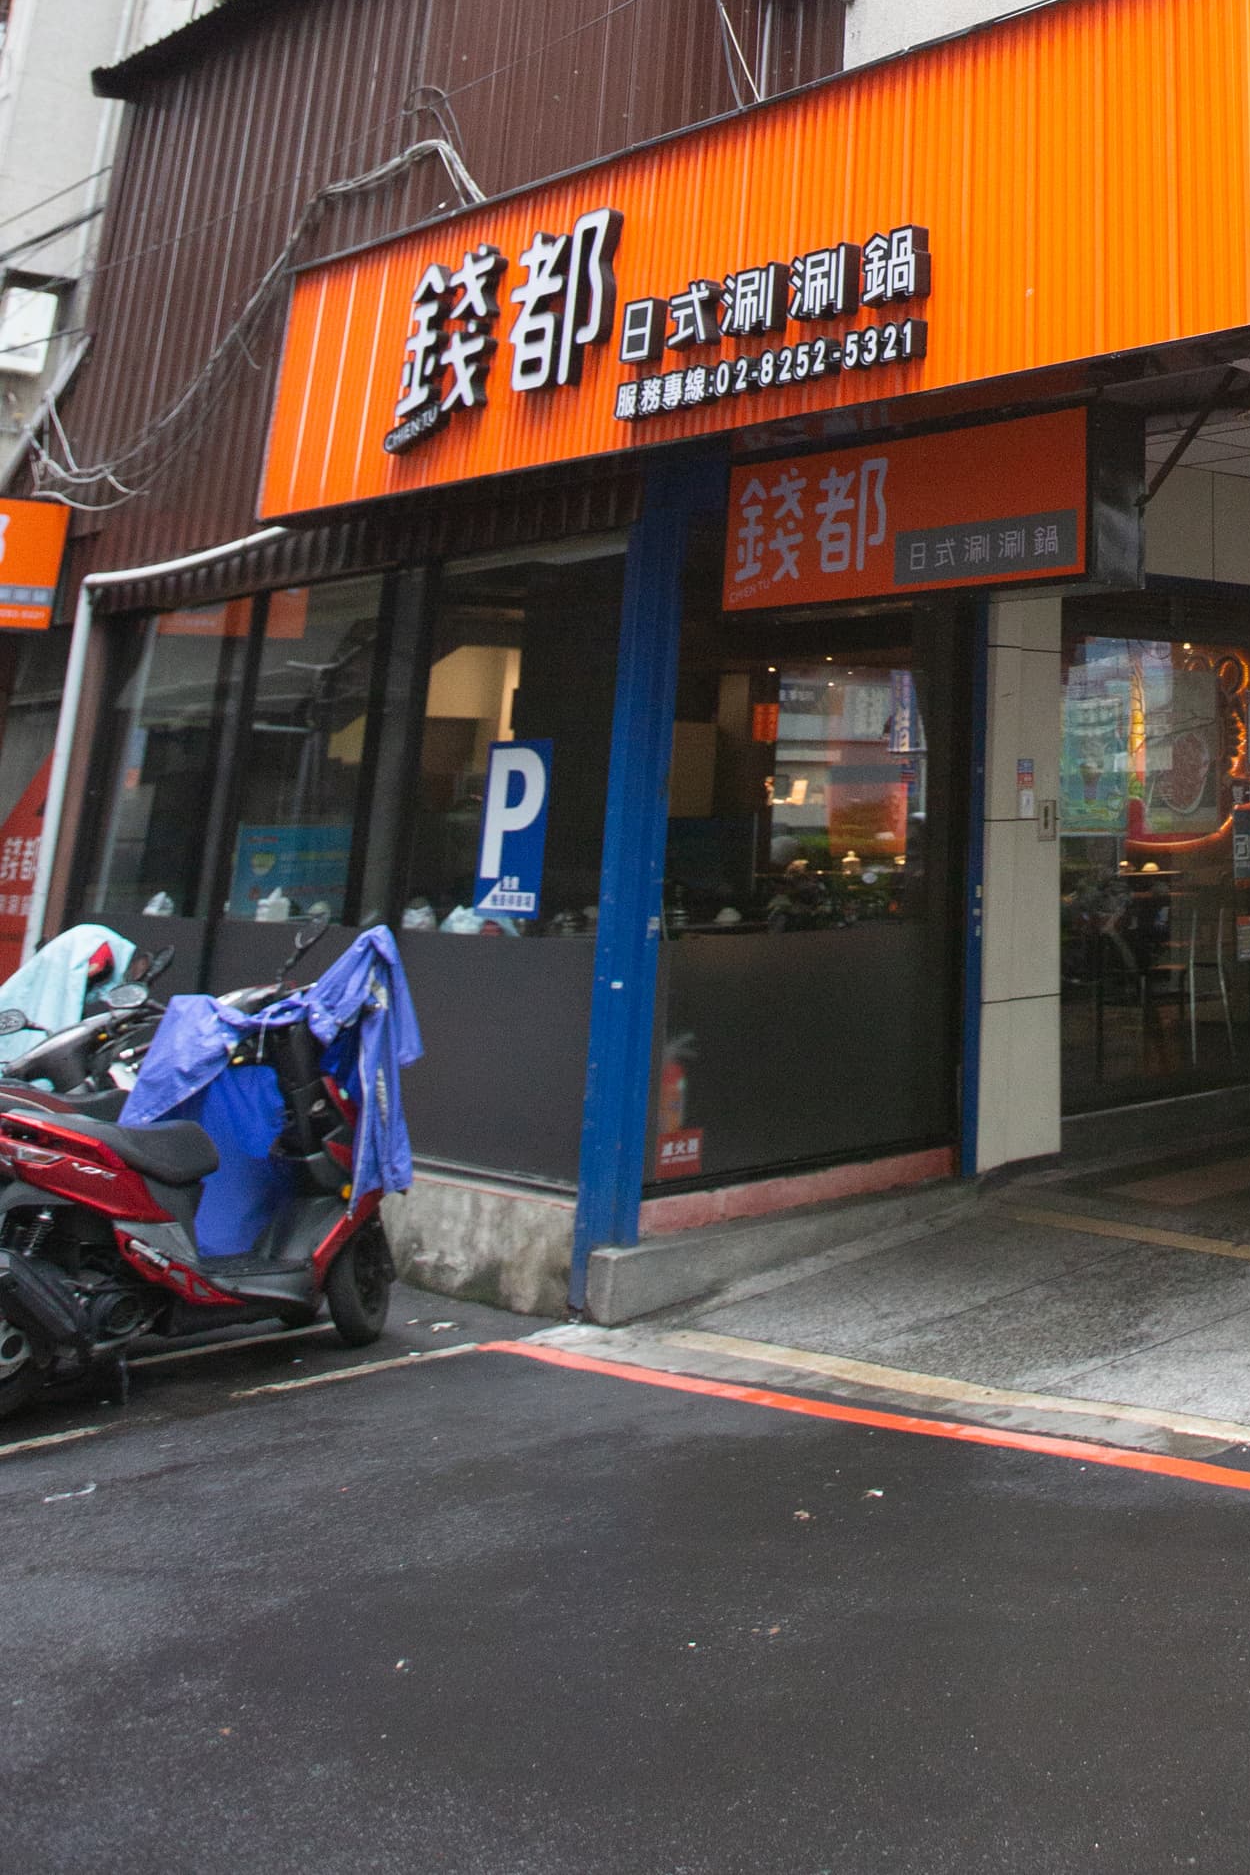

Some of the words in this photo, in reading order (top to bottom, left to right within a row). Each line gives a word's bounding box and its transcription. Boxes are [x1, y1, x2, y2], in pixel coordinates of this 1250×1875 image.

[395, 208, 612, 415] 錢都
[619, 225, 917, 364] 日式涮涮鍋
[386, 419, 420, 450] CHIEN
[423, 405, 438, 427] TU
[735, 458, 890, 581] 錢都
[908, 525, 1060, 572] 日式涮涮鍋
[480, 747, 545, 879] P
